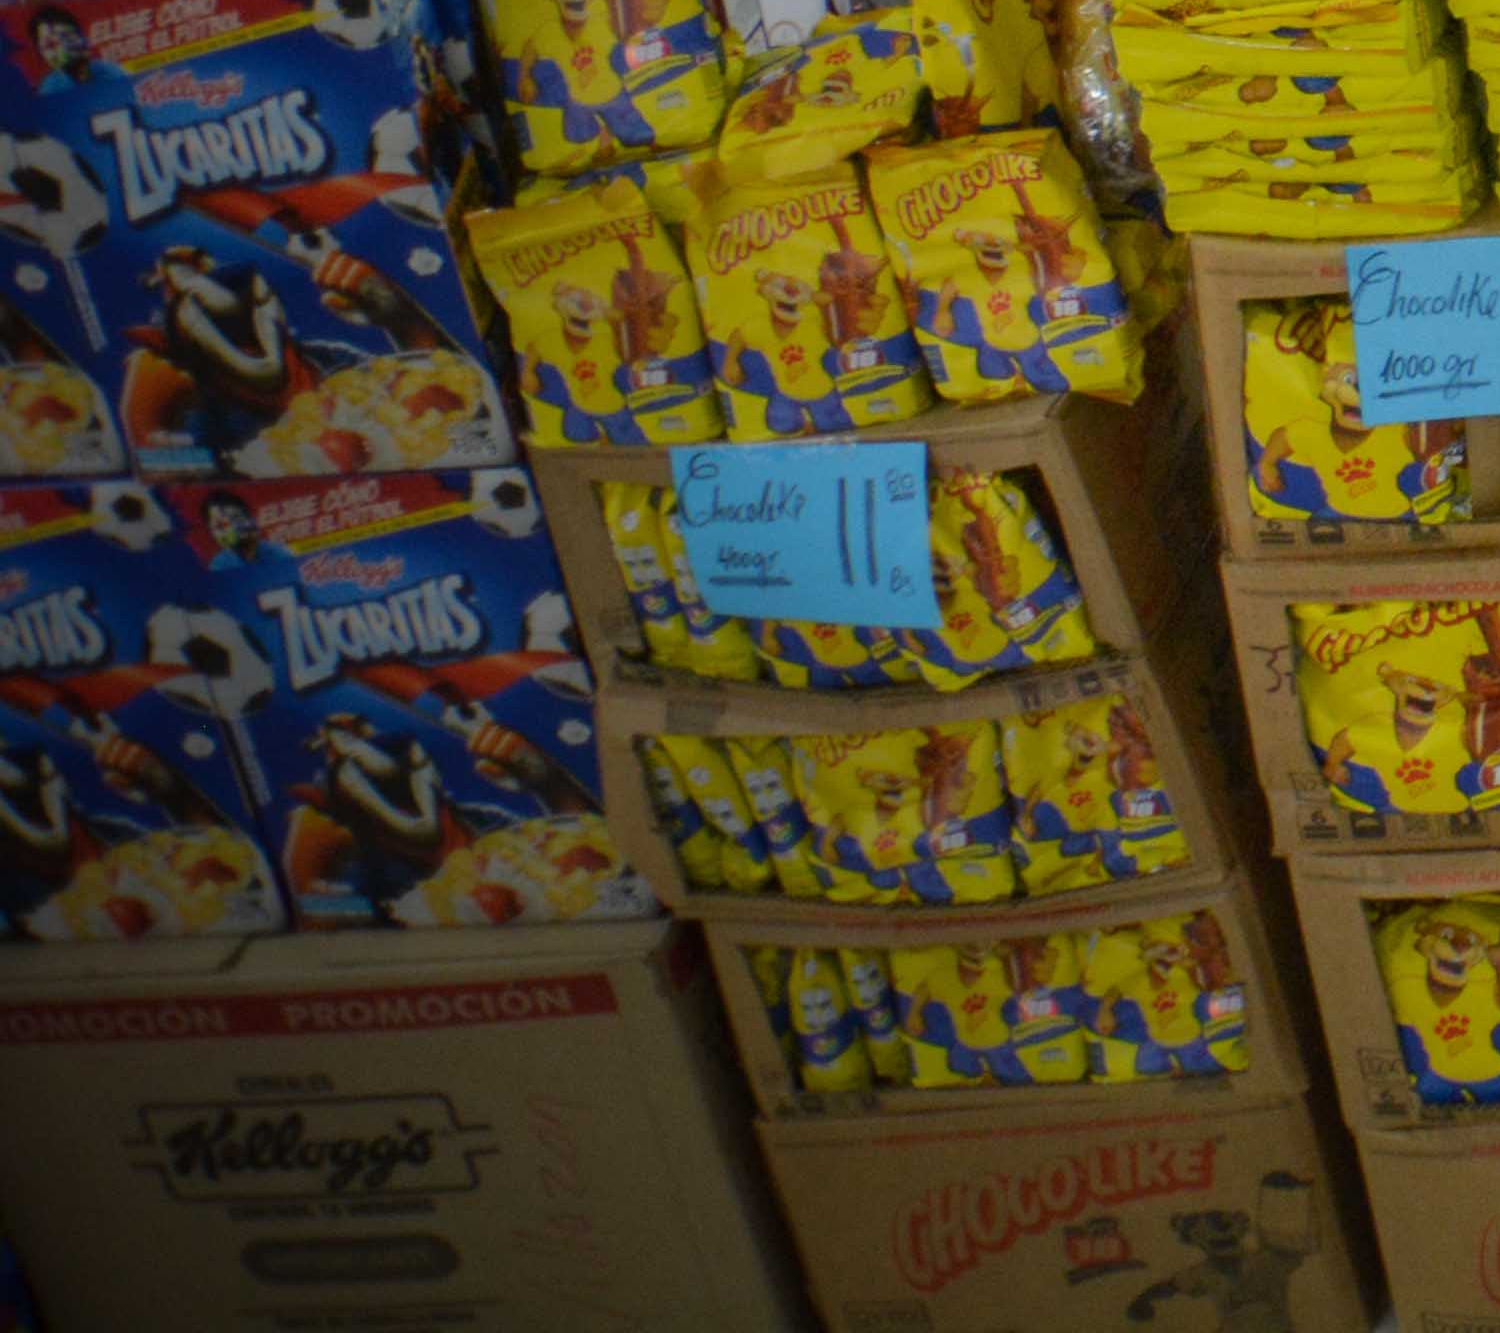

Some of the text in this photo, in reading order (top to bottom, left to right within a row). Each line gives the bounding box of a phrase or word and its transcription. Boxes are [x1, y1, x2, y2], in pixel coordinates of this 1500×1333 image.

[133, 71, 245, 107] Kellogg's
[91, 89, 328, 228] ZUCARITAS
[896, 146, 1044, 237] CHOCOLIKE
[705, 187, 867, 276] CHOCOLIKE
[1379, 351, 1439, 383] 1000
[299, 554, 404, 588] Kellogg's
[258, 581, 482, 694] ZUCARITAS
[283, 986, 572, 1026] PROMOCIÓN
[167, 1108, 437, 1188] Kellogg's
[894, 1139, 1218, 1293] CHOCOLIKE
